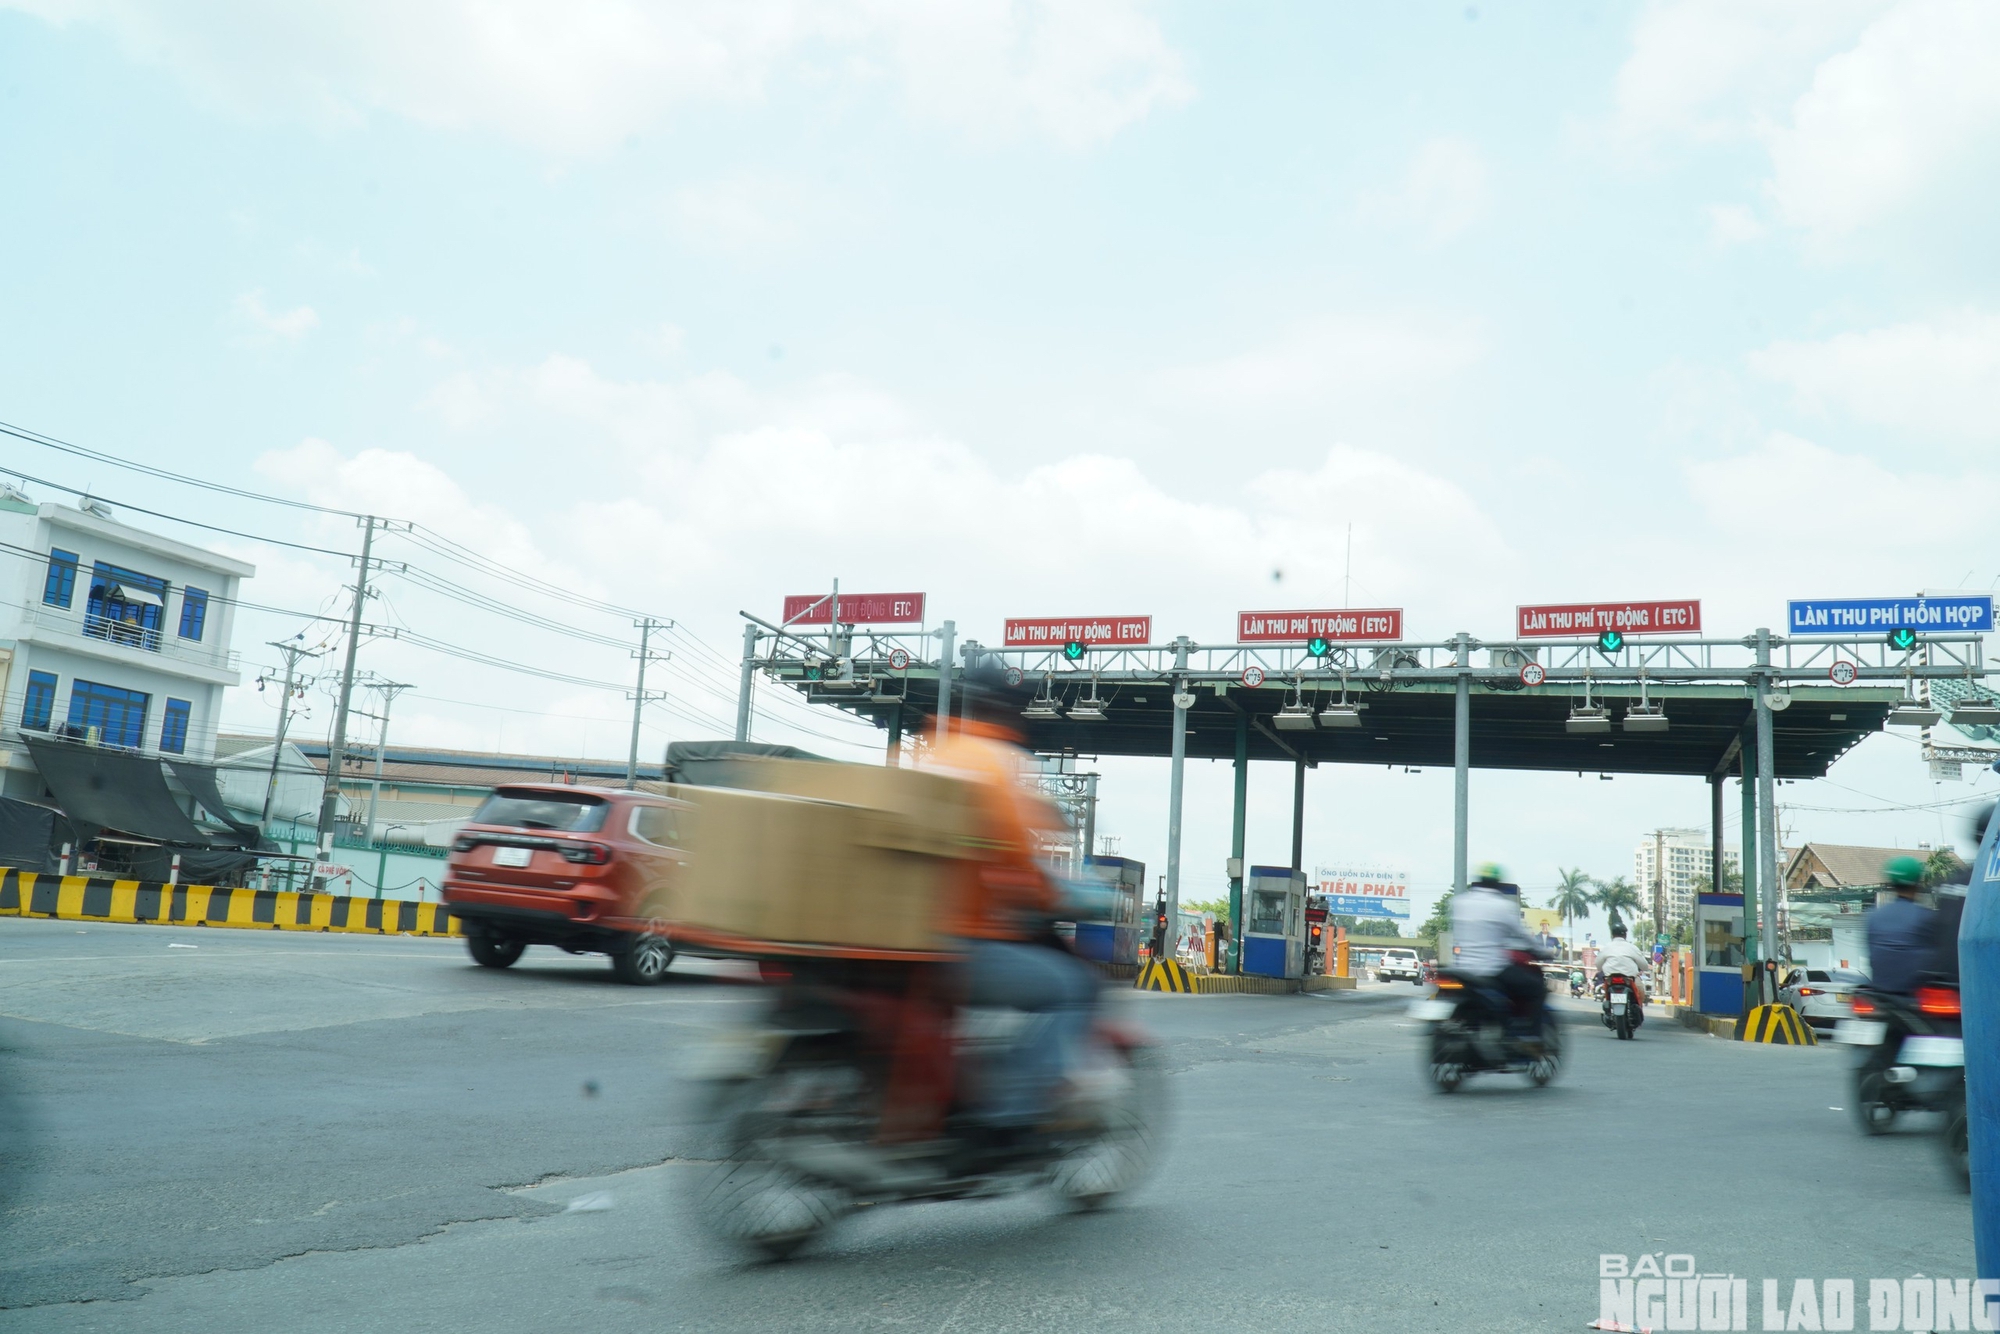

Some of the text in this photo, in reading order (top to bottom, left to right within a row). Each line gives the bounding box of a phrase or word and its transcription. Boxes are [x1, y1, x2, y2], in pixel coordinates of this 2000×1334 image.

[860, 600, 885, 619] ĐỘNG
[1524, 610, 1546, 629] LÀN
[1549, 613, 1572, 628] THU
[1575, 608, 1595, 627] PHÍ
[1597, 610, 1614, 631] TỰ
[1616, 606, 1648, 630] ĐỘNG
[1795, 600, 1983, 628] LÀN THU PHÍ HỖN HỢP
[1007, 620, 1146, 642] LÀN THU PHÍ TỰ ĐỘNG (ETC)
[1244, 616, 1264, 634] LÀN
[1267, 619, 1288, 634] THU
[1291, 616, 1309, 634] PHÍ
[1311, 618, 1326, 637] TỰ
[1327, 614, 1357, 636] ĐỘNG
[1377, 872, 1393, 880] ĐIỆN
[1321, 878, 1405, 897] TIẾN PHÁT
